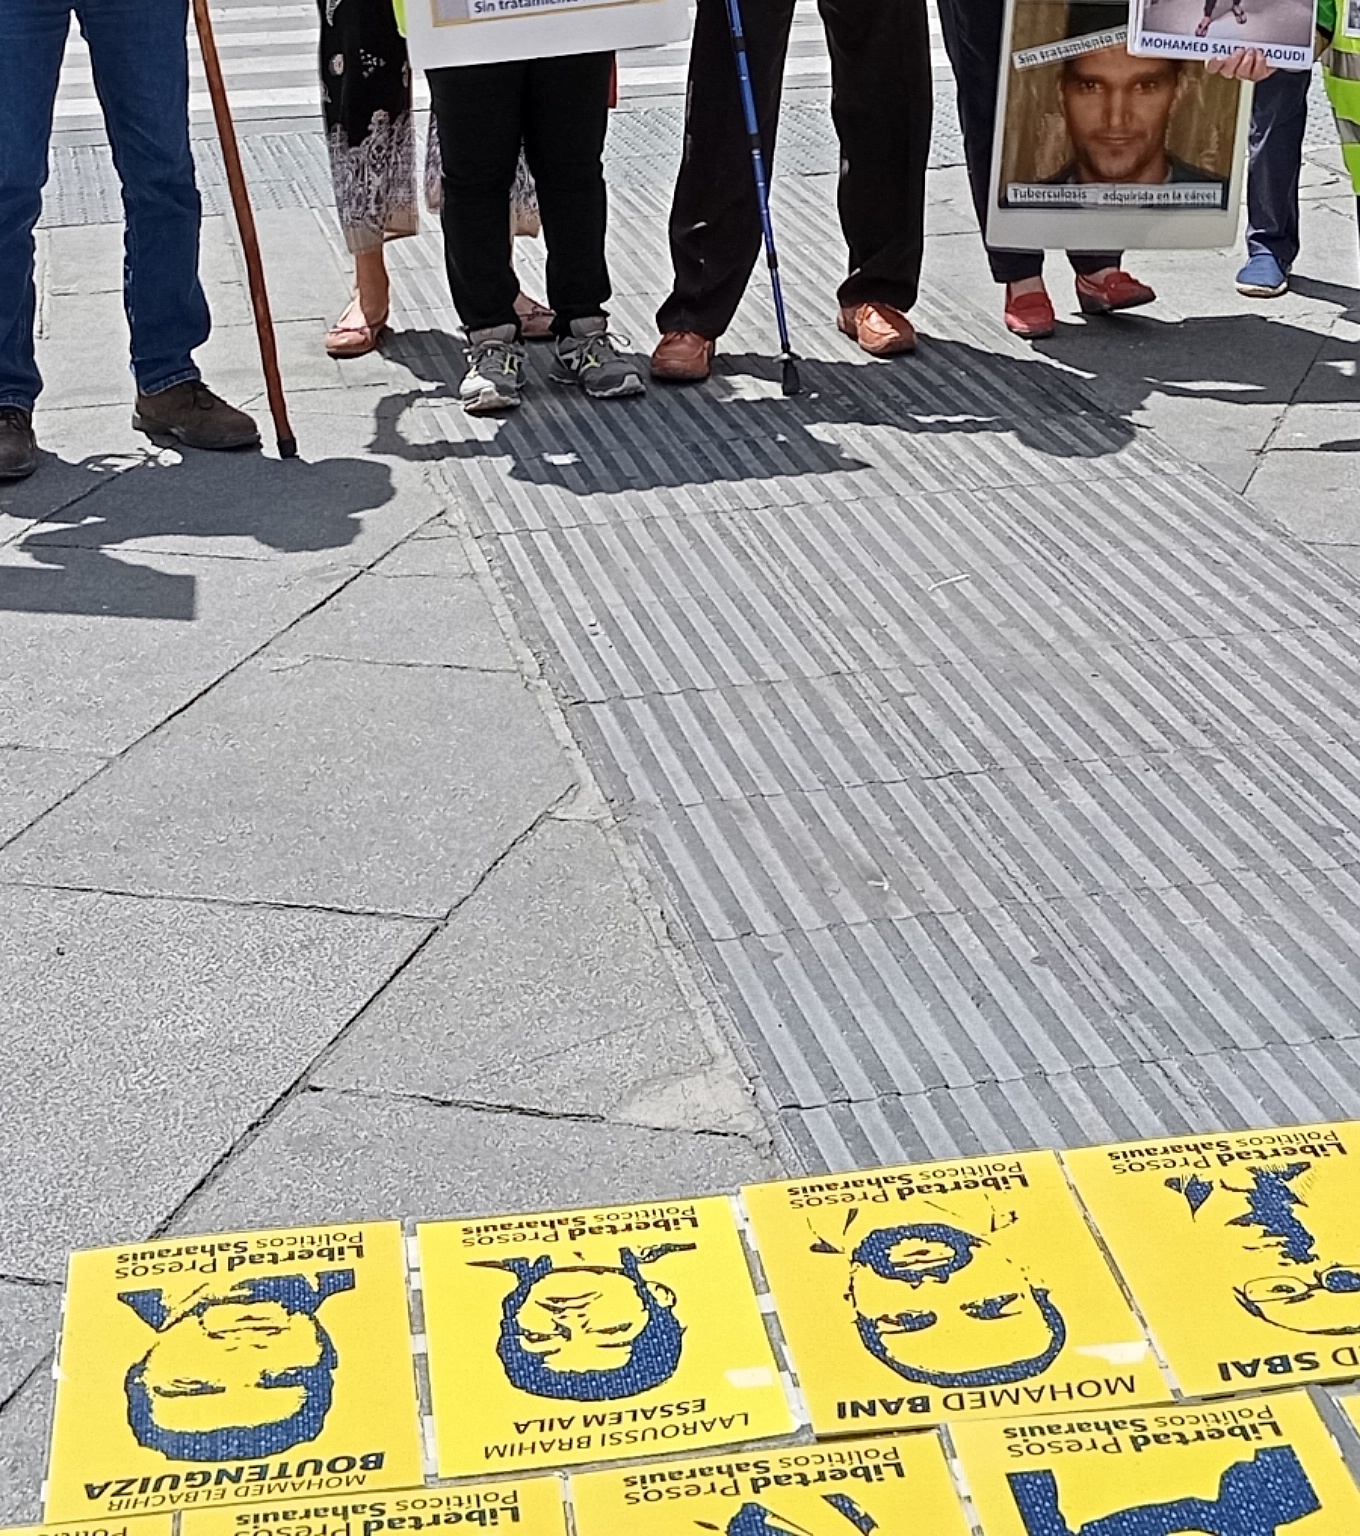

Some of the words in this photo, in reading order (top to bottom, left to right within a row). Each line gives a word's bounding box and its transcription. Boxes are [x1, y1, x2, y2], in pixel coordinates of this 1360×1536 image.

[474, 0, 496, 14] Sin
[1017, 52, 1038, 65] Sin
[1040, 33, 1113, 62] tratamiento
[1141, 35, 1209, 54] MOHAMED
[1011, 187, 1088, 201] Tuberculosis
[1102, 188, 1154, 203] adquirida
[1156, 189, 1170, 201] en
[1172, 188, 1181, 201] la
[1236, 1129, 1339, 1147] Políticos
[1108, 1139, 1231, 1162] Saharauis
[1216, 1141, 1348, 1167] Libertad
[919, 1161, 1023, 1181] Políticos
[1112, 1155, 1211, 1175] Presos
[788, 1172, 913, 1197] Saharauis
[896, 1172, 1030, 1201] Libertad
[790, 1189, 890, 1209] Presos
[462, 1215, 585, 1237] Saharauis
[593, 1205, 695, 1223] Políticos
[256, 1230, 363, 1249] Políticos
[462, 1229, 560, 1247] Presos
[569, 1216, 700, 1241] Libertad
[117, 1240, 248, 1266] Saharauis
[228, 1244, 365, 1272] Libertad
[115, 1257, 217, 1279] Presos
[1217, 1351, 1320, 1382] SBAI
[943, 1374, 1136, 1412] MOHAMED
[582, 1398, 707, 1428] ESSALEM
[836, 1394, 931, 1420] BANI
[514, 1418, 575, 1435] AILA
[601, 1411, 750, 1447] LAAROUSSI
[484, 1433, 592, 1460] BRAHIM
[84, 1452, 386, 1501] BOUTENGUIZA
[234, 1474, 366, 1498] MOHAMED
[108, 1487, 227, 1512] ELBACHIR
